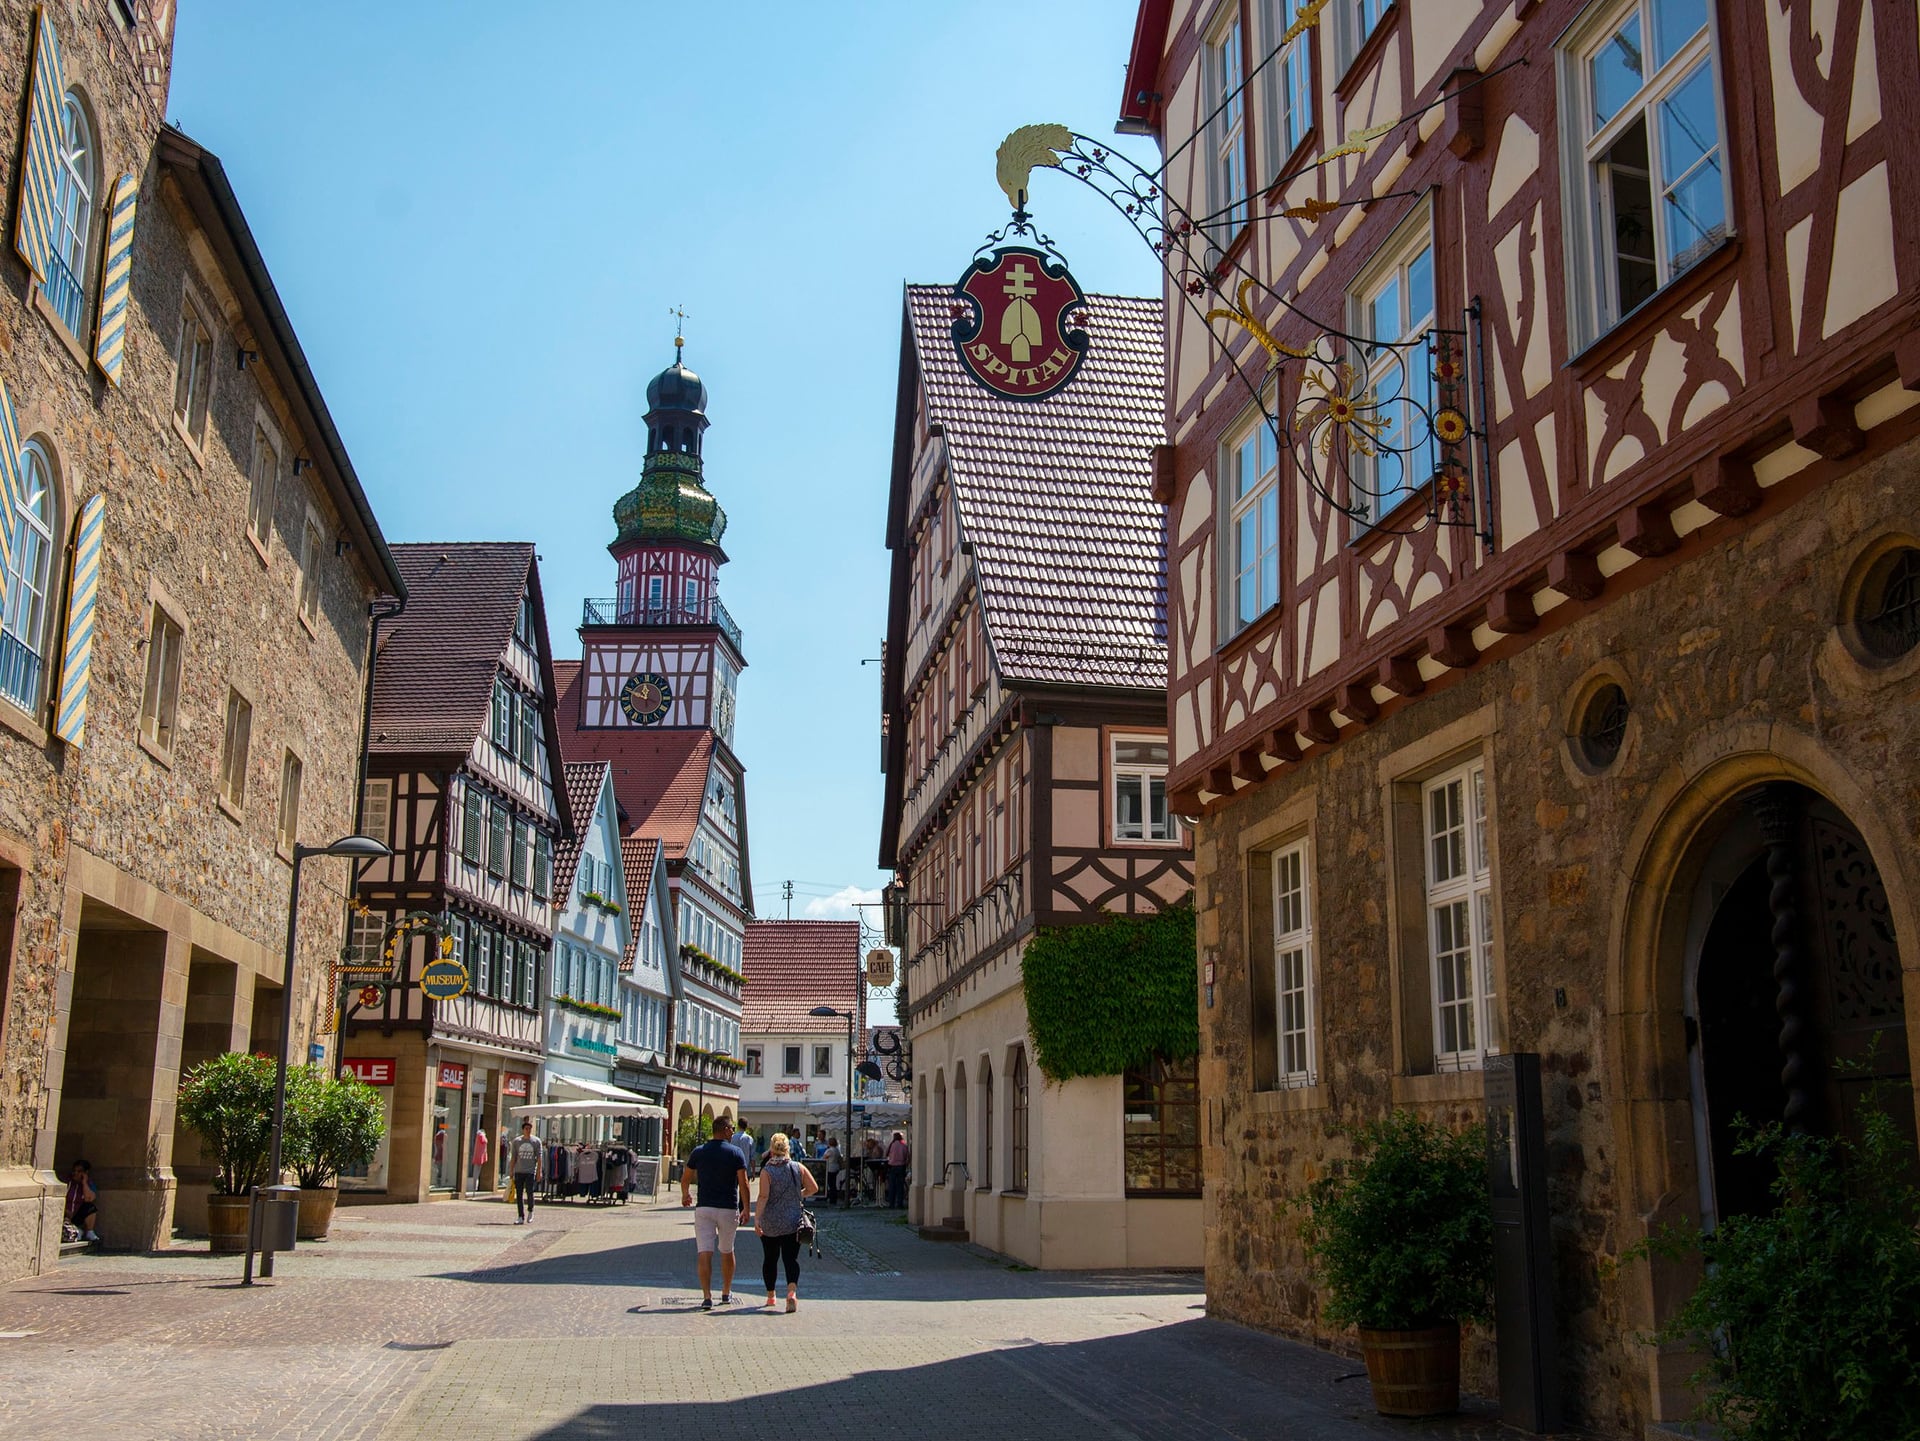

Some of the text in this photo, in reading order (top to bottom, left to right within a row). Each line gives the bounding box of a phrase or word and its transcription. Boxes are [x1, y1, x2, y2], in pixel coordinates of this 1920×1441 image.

[969, 343, 1072, 386] SPITAL
[425, 974, 464, 985] MUSEUM
[341, 1064, 388, 1080] ALE
[443, 1068, 465, 1085] SALE
[509, 1078, 526, 1093] SALE
[774, 1083, 811, 1093] ESPRIT
